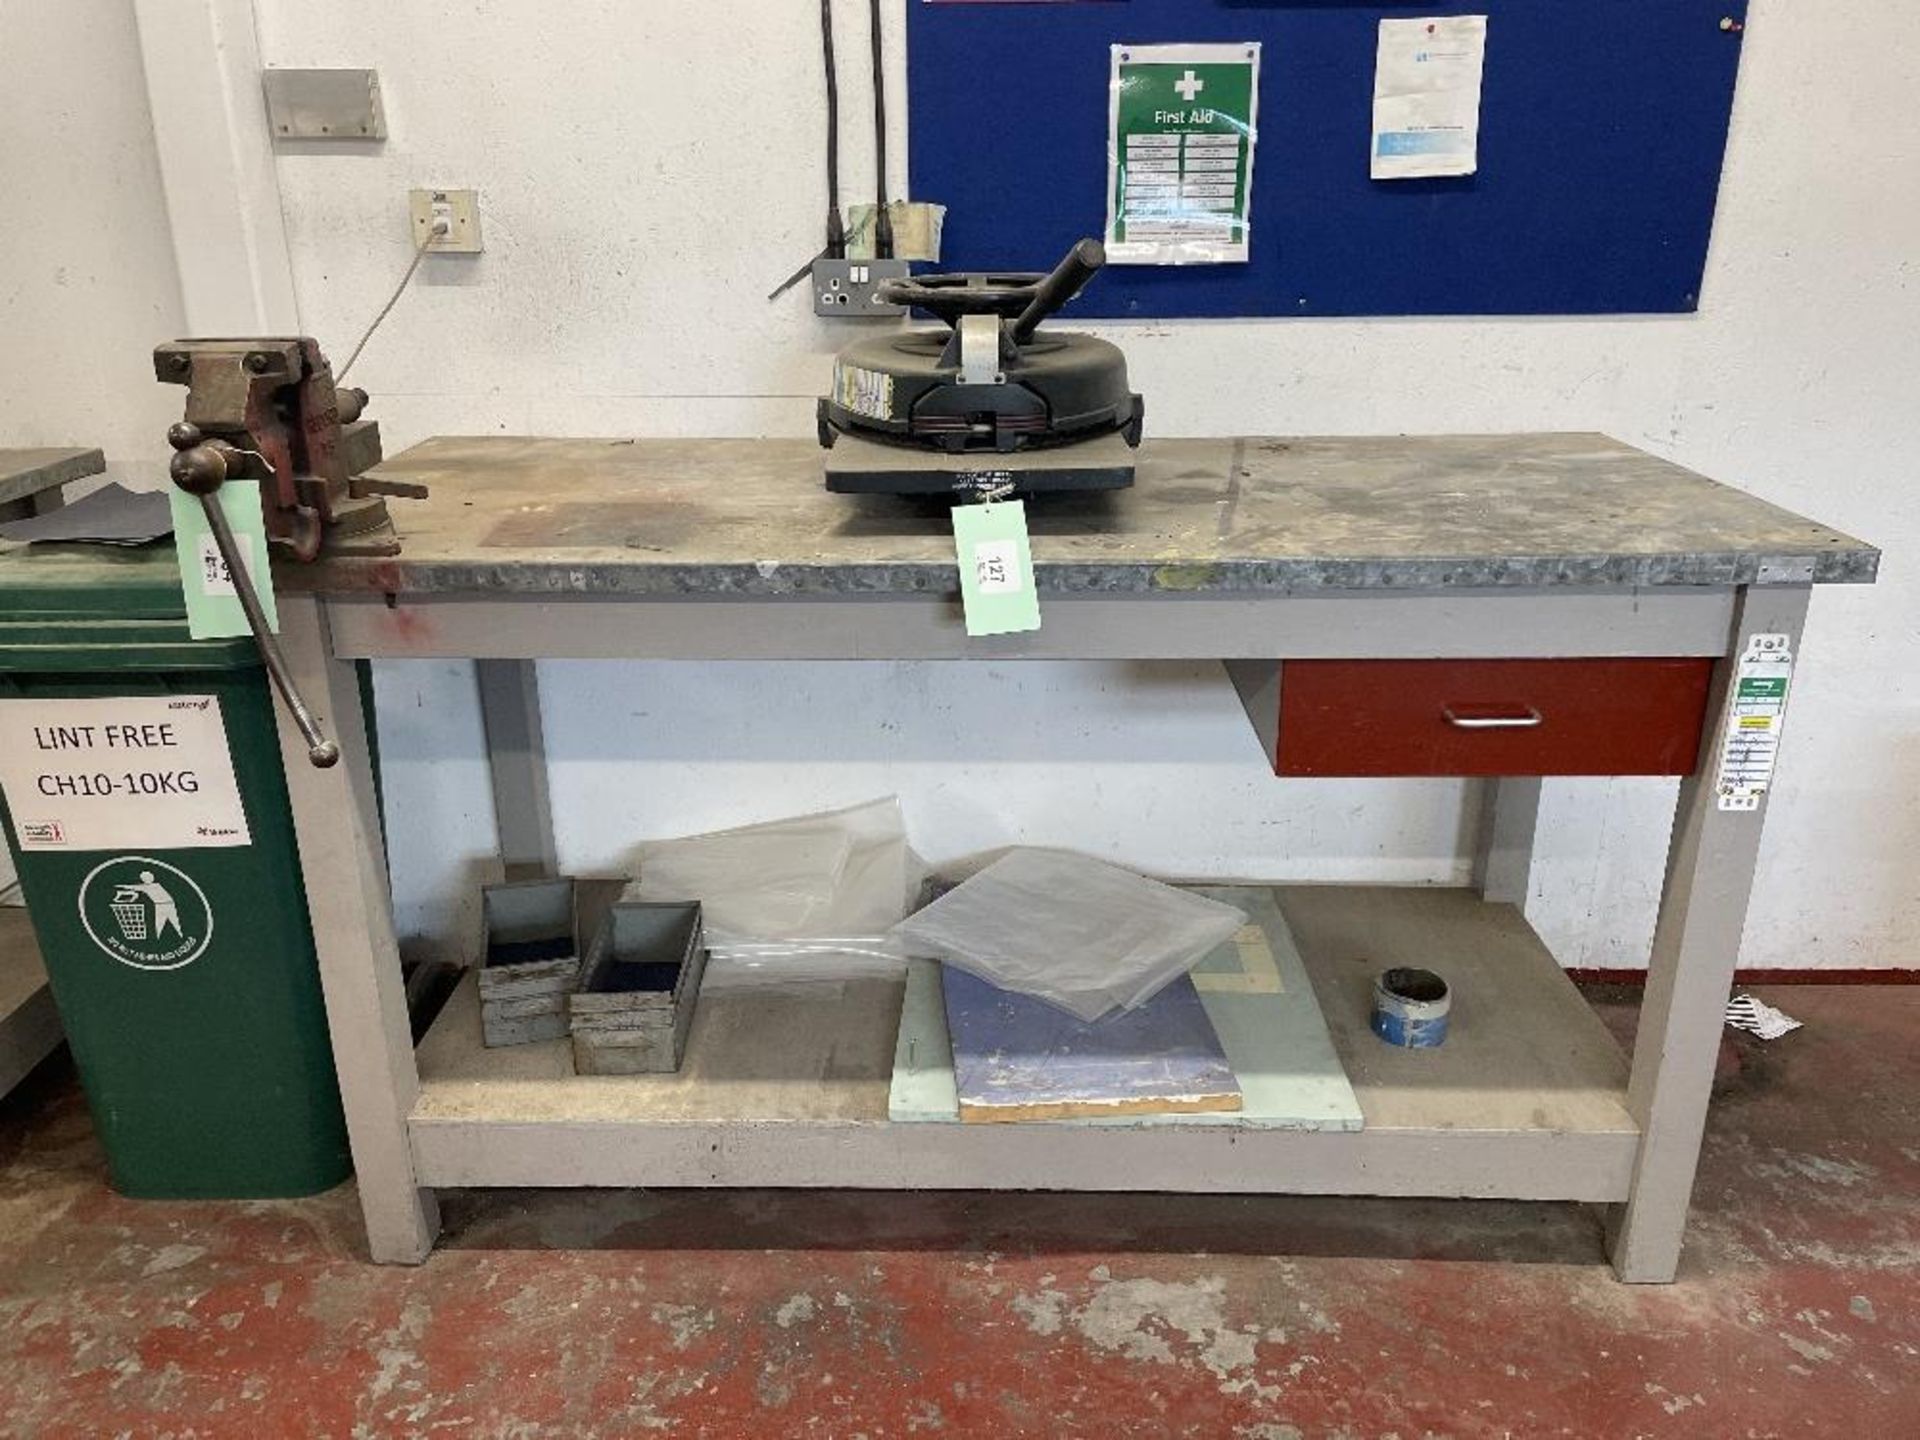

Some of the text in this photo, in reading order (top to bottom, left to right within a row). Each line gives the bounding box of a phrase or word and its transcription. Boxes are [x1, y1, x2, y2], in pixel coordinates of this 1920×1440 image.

[1155, 109, 1214, 124] First Aid
[988, 556, 1005, 583] 127
[34, 723, 178, 750] LINT FREE
[37, 770, 199, 796] CH10-10KG
